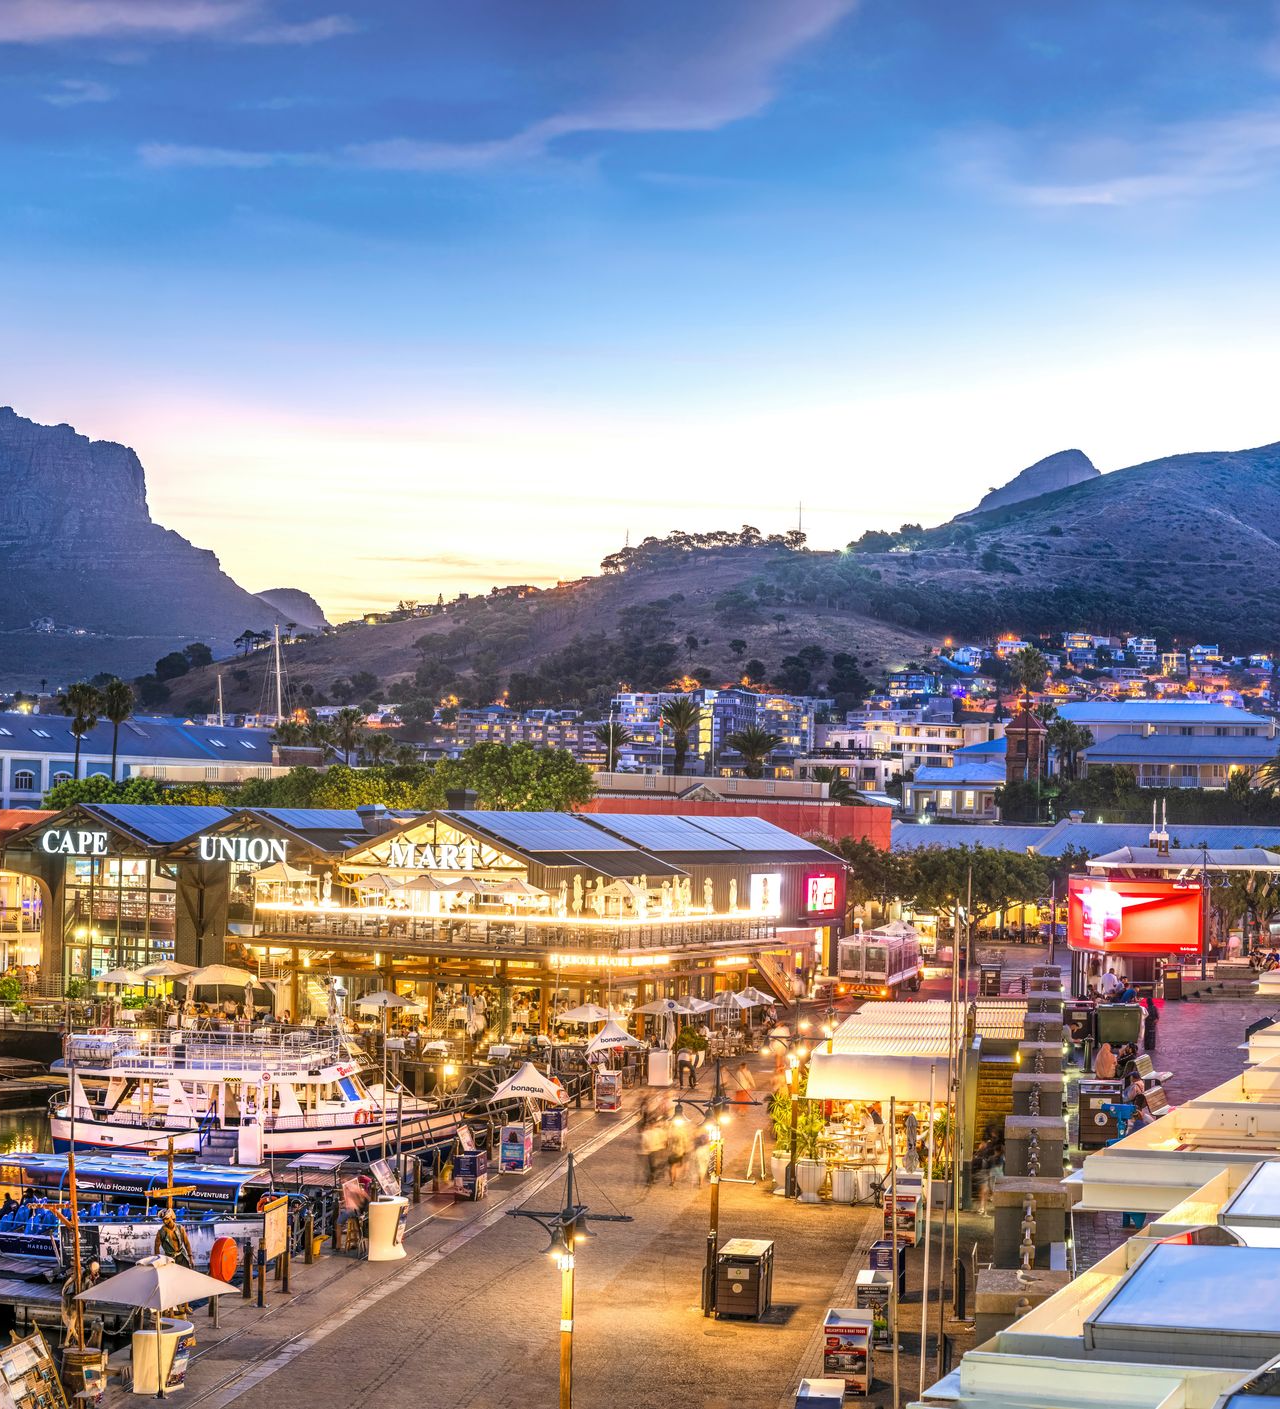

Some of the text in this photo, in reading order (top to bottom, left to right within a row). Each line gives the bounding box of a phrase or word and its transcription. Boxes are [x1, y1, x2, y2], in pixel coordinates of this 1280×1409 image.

[42, 830, 108, 855] CAPE
[199, 836, 289, 862] UNION
[389, 843, 480, 870] MART
[112, 1184, 143, 1192] HORIZONS
[191, 1190, 229, 1199] ADVENTURES
